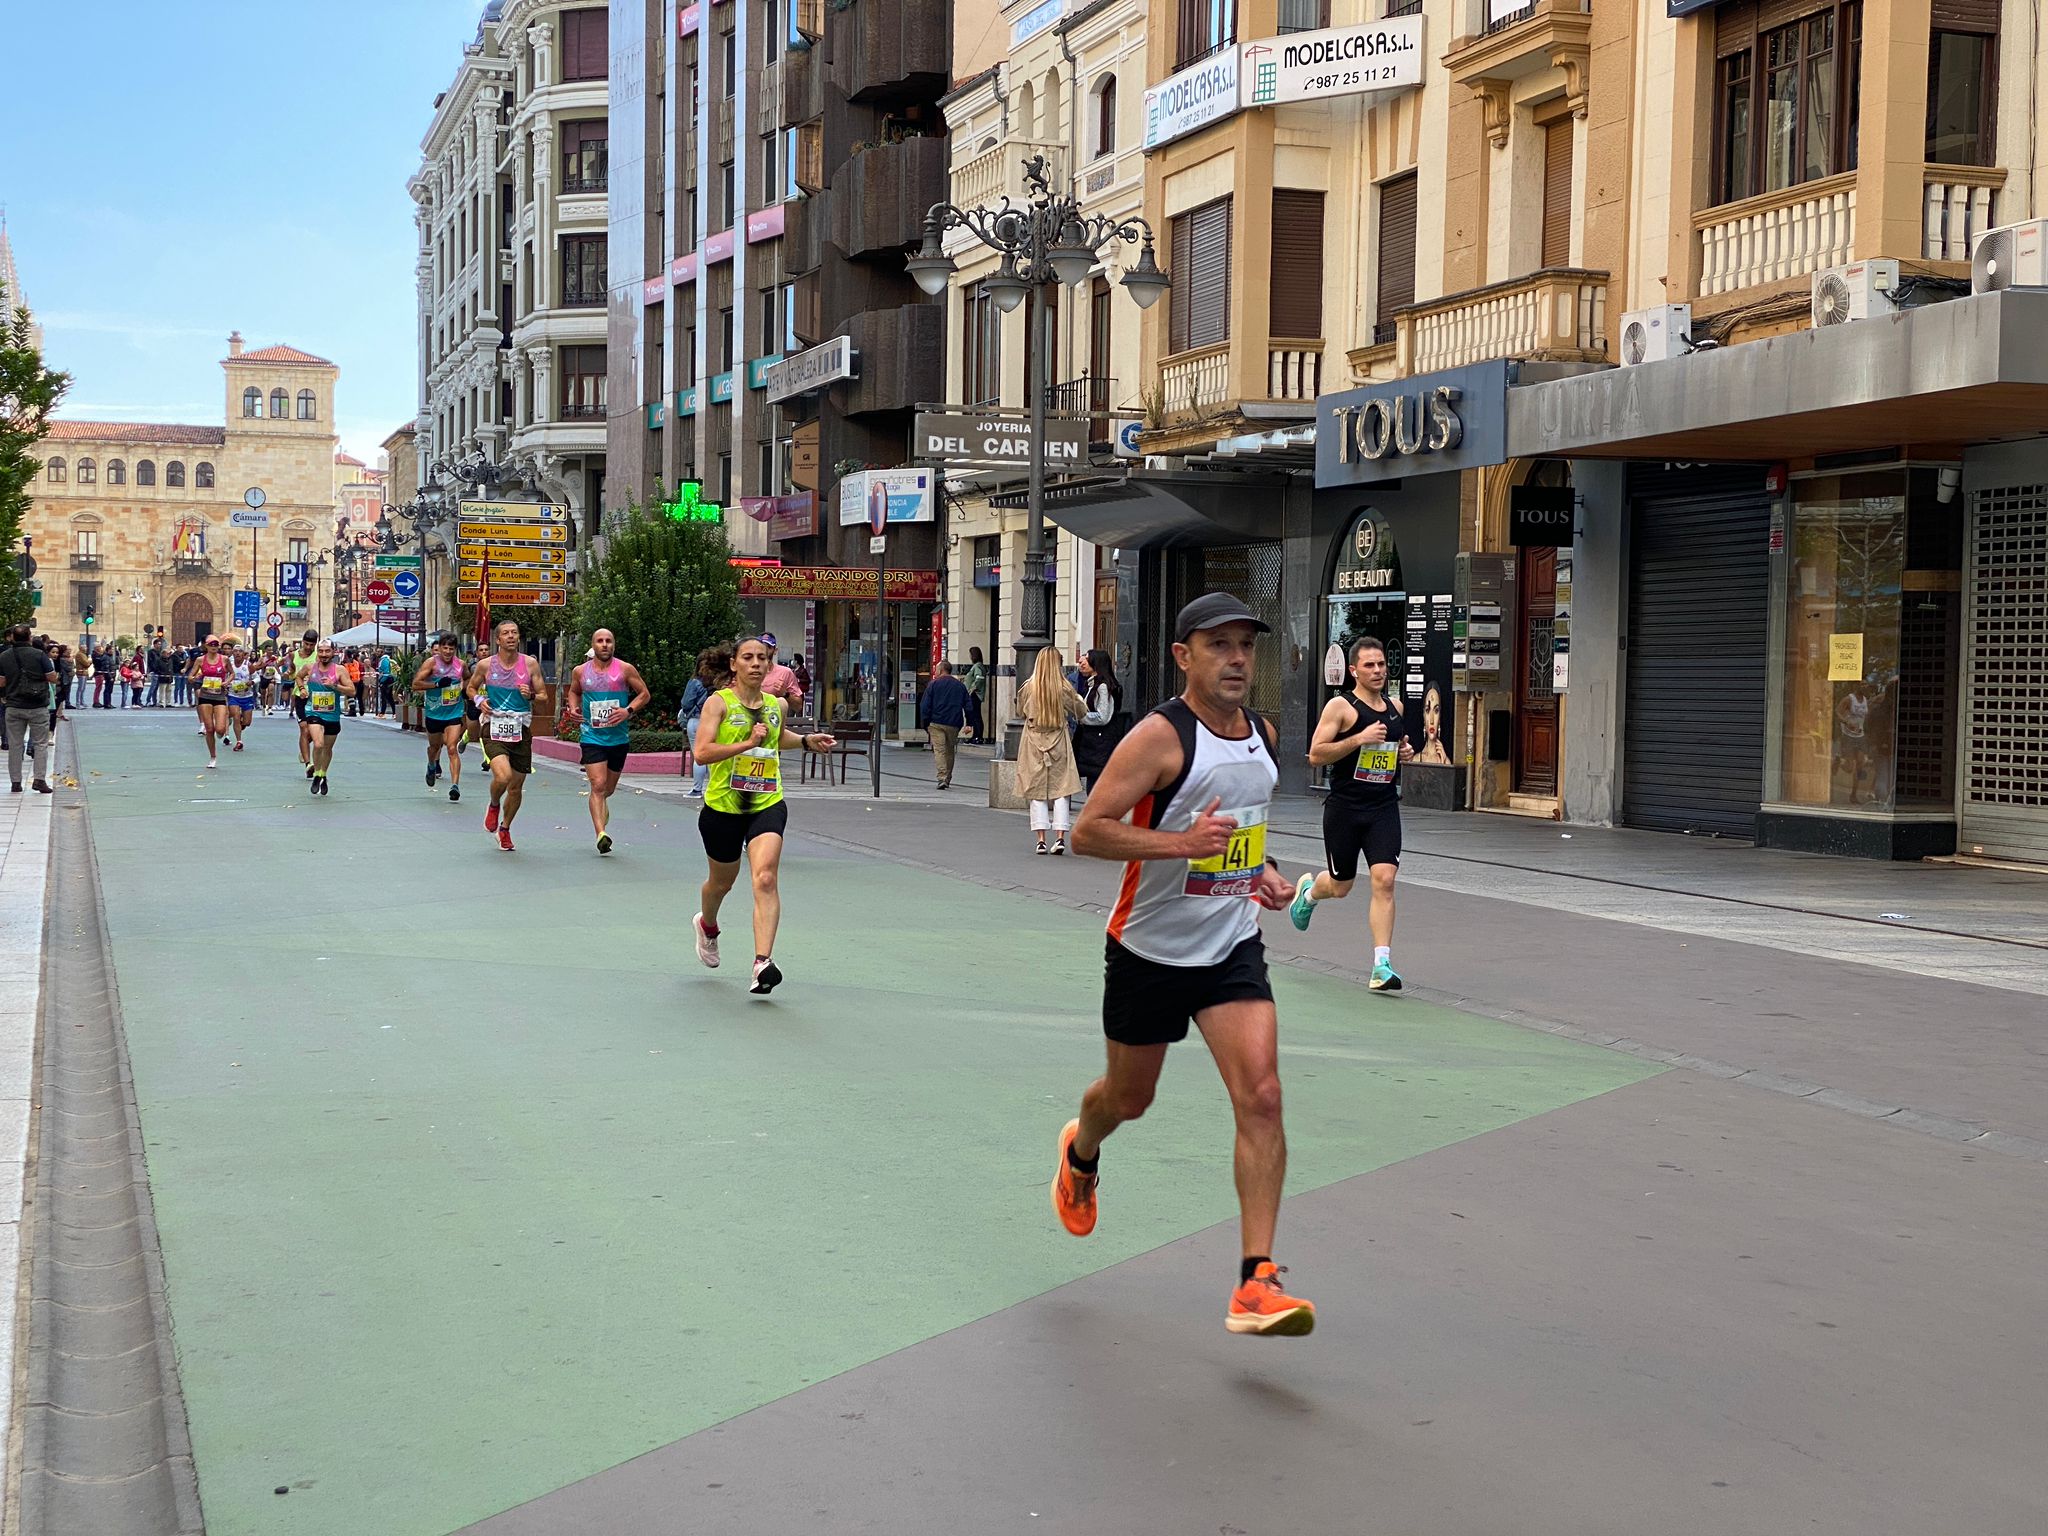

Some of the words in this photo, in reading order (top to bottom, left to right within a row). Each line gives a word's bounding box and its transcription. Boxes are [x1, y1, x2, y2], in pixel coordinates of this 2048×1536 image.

[1316, 72, 1338, 89] 987
[1343, 71, 1360, 85] 25
[1364, 69, 1377, 83] 11
[1383, 66, 1397, 80] 21
[1182, 114, 1192, 128] 987
[976, 422, 1032, 434] JOYERIA
[1332, 386, 1462, 464] TOUS
[928, 435, 971, 454] DEL
[232, 512, 267, 523] Cámara
[1516, 508, 1570, 524] TOUS
[462, 526, 487, 535] Conde
[1358, 529, 1371, 548] BE
[461, 548, 477, 556] Luis
[494, 548, 513, 558] León
[282, 563, 297, 586] P
[500, 570, 530, 580] Antonio
[740, 567, 806, 579] ROYAL
[813, 569, 915, 583] TANDOORI
[1338, 571, 1353, 589] BE
[1353, 568, 1393, 589] BEAUTY
[368, 588, 389, 596] STOP
[791, 581, 860, 590] RESTAURANT
[489, 592, 514, 600] Conde
[516, 593, 535, 601] Luna
[1388, 649, 1400, 667] BE
[318, 697, 329, 705] 176
[498, 724, 514, 734] 598
[750, 761, 765, 777] 20
[1371, 754, 1389, 770] 135
[1222, 837, 1249, 870] 141
